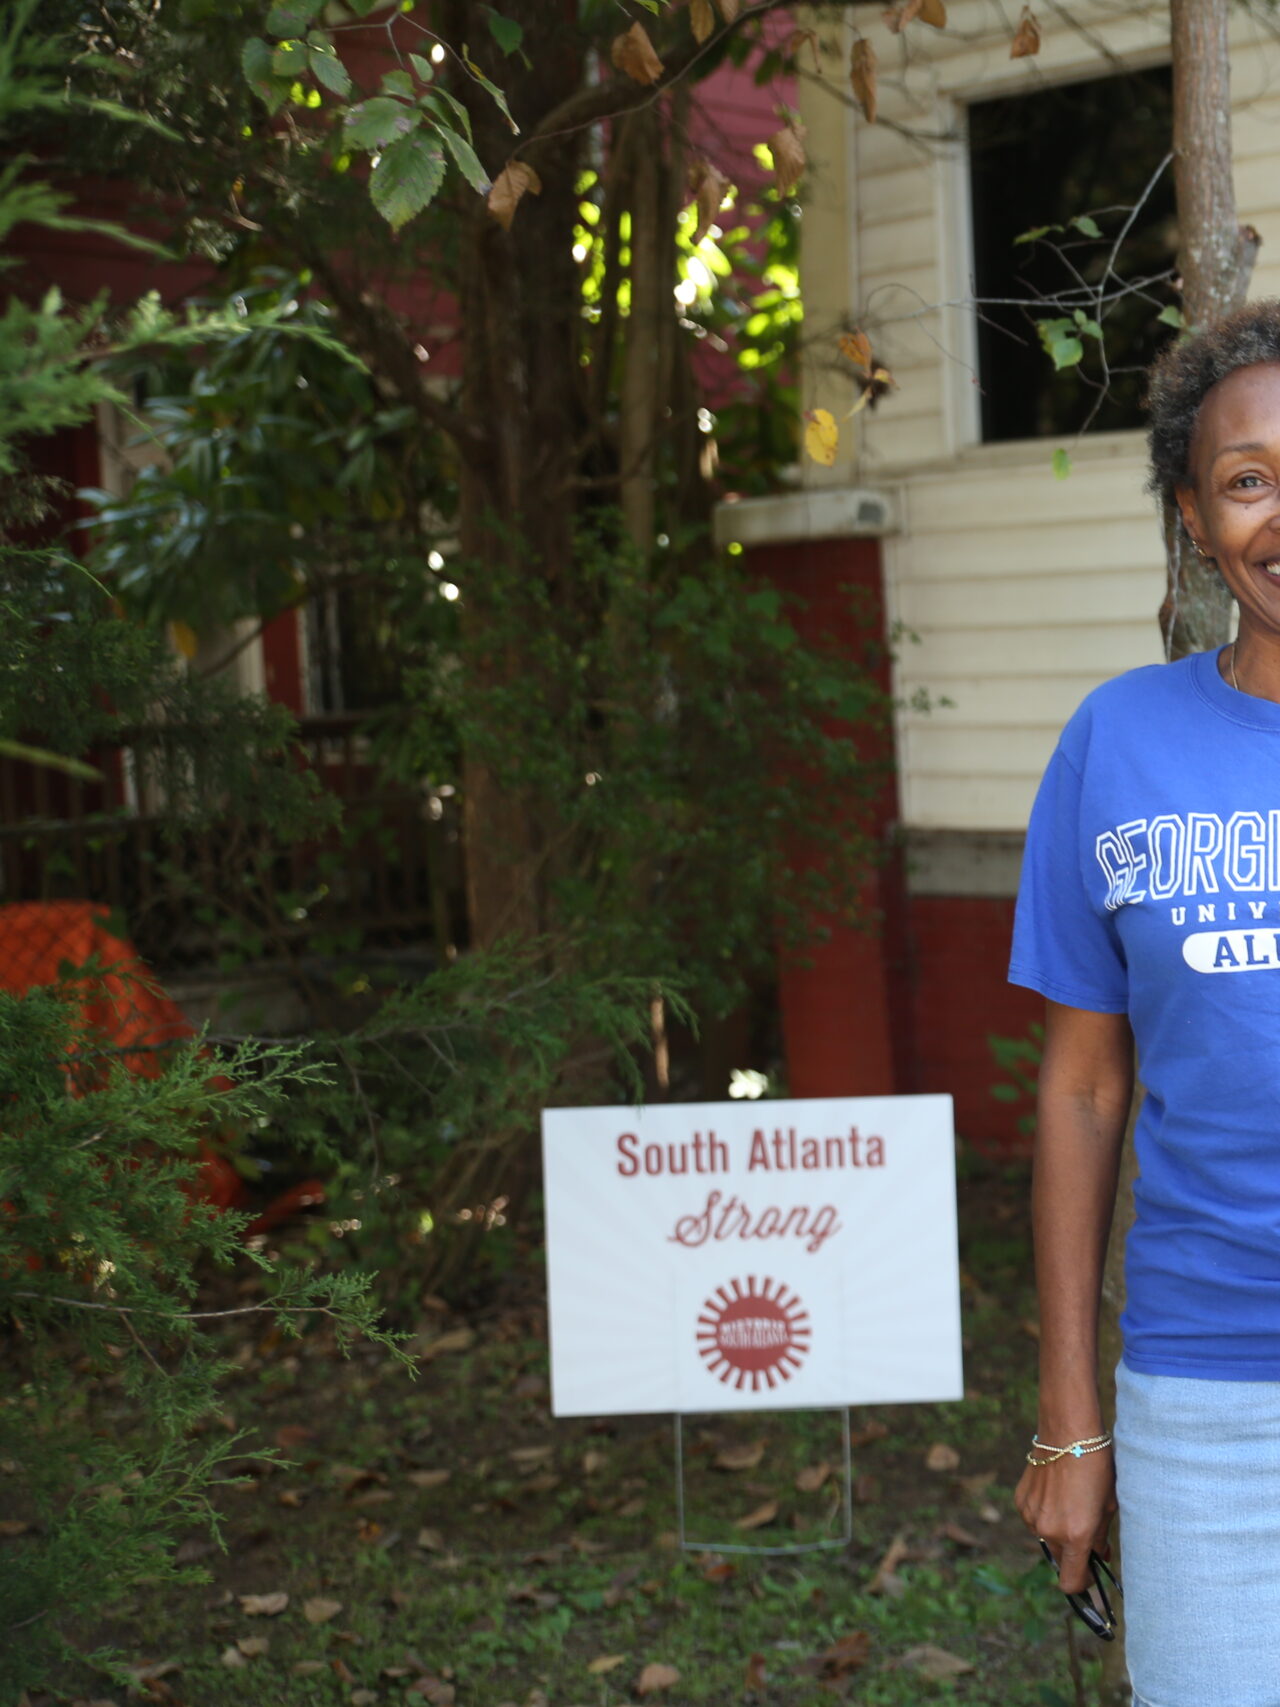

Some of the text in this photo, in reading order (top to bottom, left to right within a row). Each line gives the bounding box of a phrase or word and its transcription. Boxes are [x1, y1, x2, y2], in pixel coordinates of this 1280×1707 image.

[615, 1126, 887, 1177] South Atlanta
[666, 1190, 842, 1254] Strong
